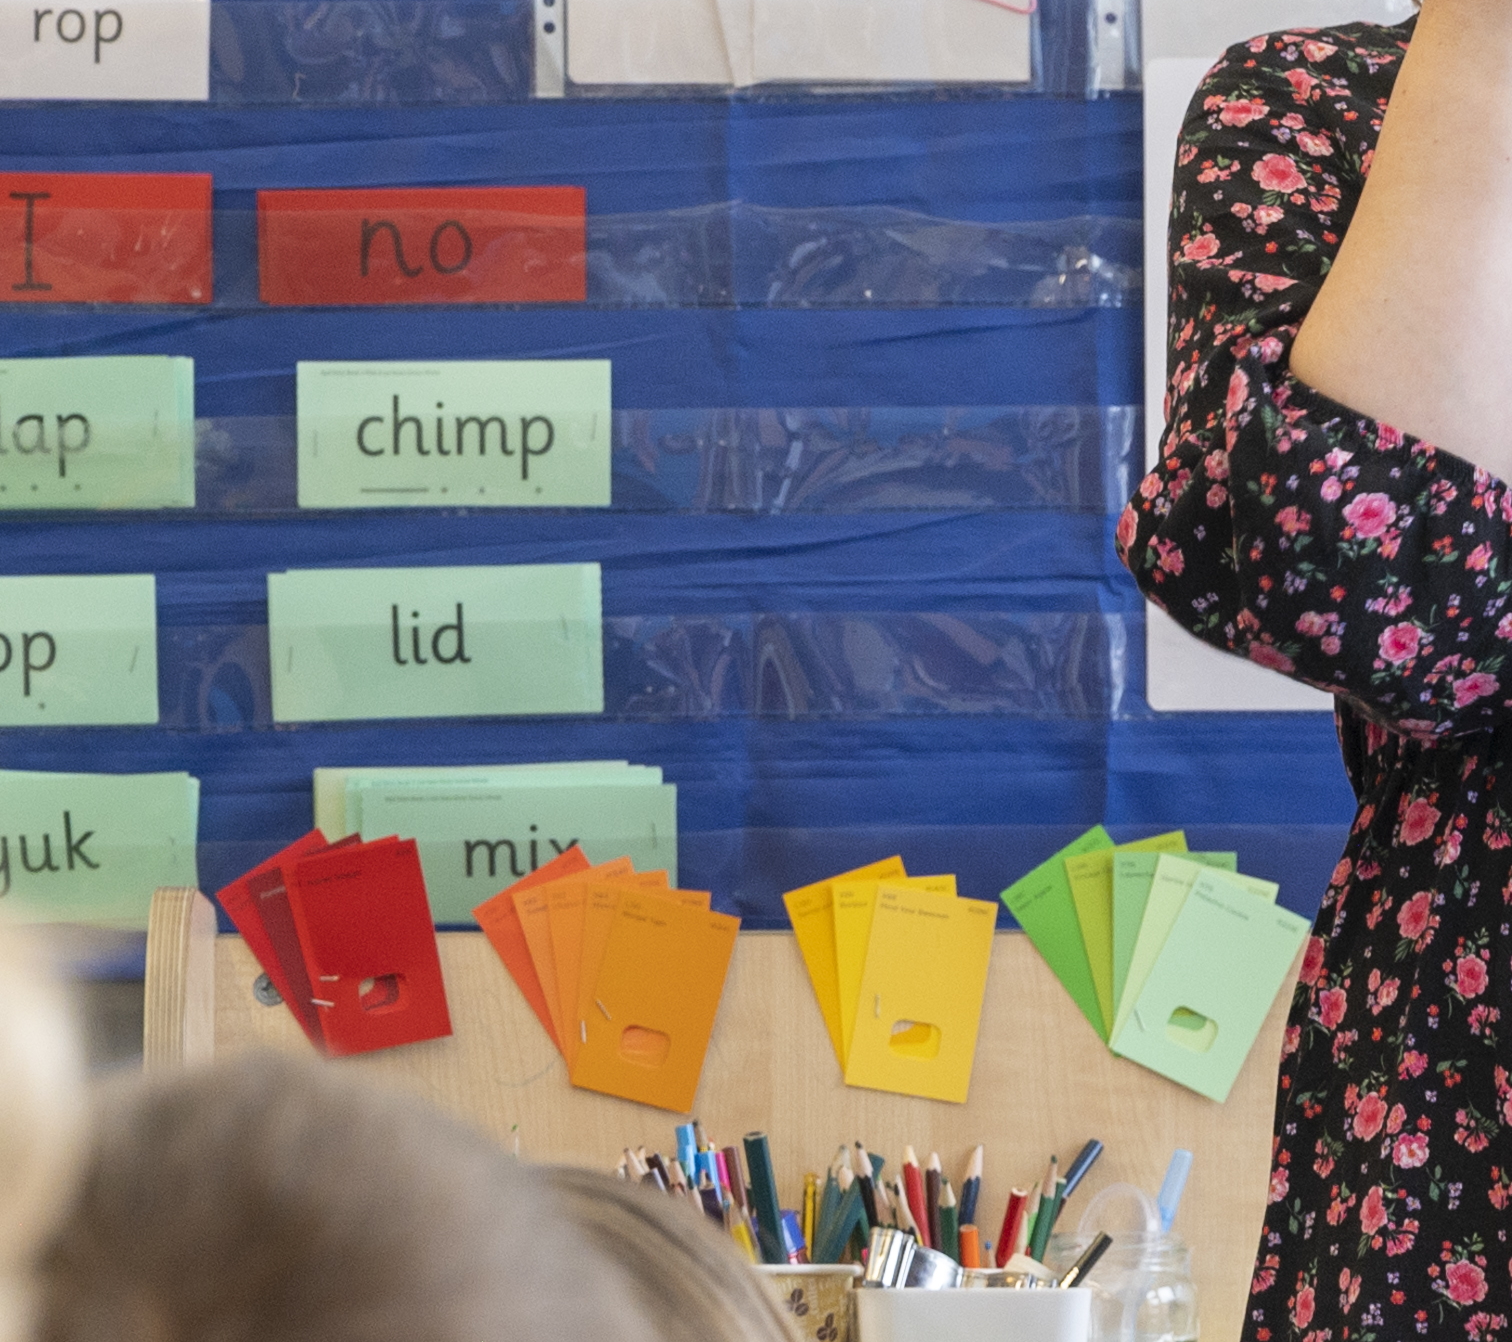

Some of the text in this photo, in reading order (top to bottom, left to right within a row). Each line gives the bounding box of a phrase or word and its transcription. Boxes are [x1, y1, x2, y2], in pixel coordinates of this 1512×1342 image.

[33, 8, 124, 64] rop
[8, 191, 53, 292] I
[359, 215, 474, 279] no
[355, 394, 556, 480] chimp
[390, 601, 473, 666] lid
